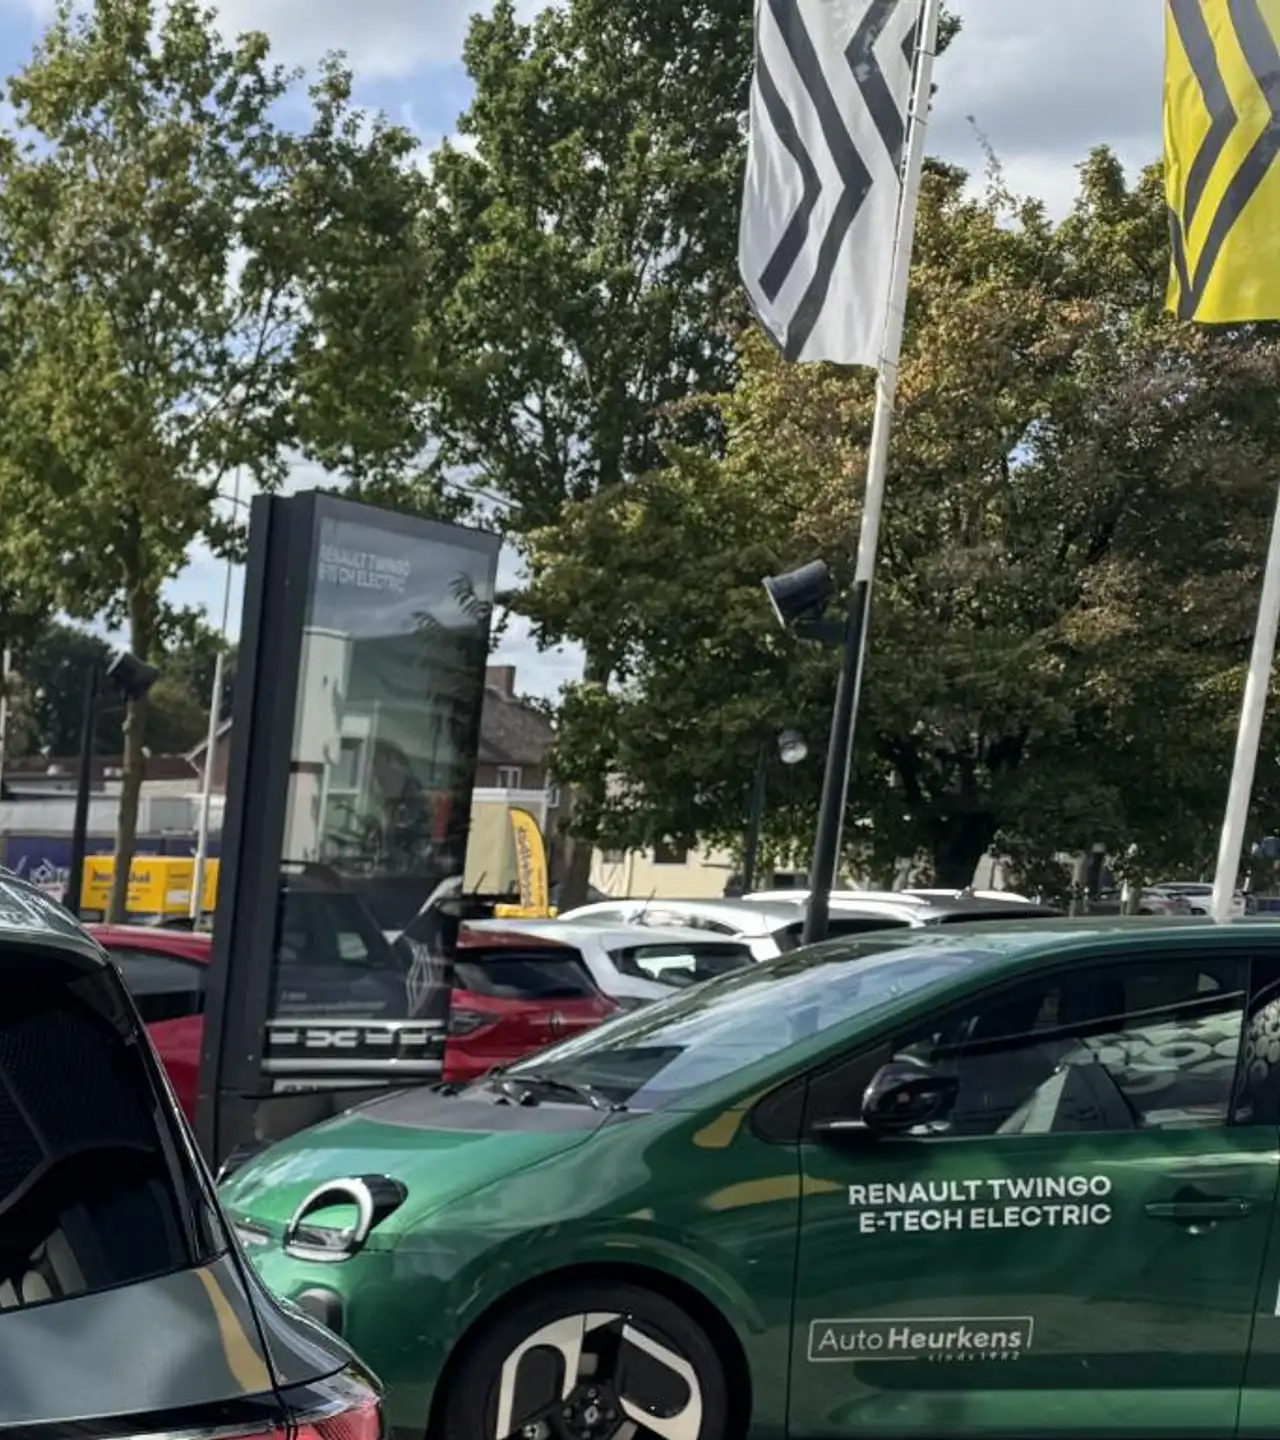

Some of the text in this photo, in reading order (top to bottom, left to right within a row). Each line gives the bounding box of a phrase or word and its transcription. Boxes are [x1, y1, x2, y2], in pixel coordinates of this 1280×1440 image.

[848, 1175, 1112, 1205] RENAULT TWINGO
[859, 1203, 1112, 1233] E-TECH ELECTRIC
[818, 1326, 1021, 1350] Auto Heurkens
